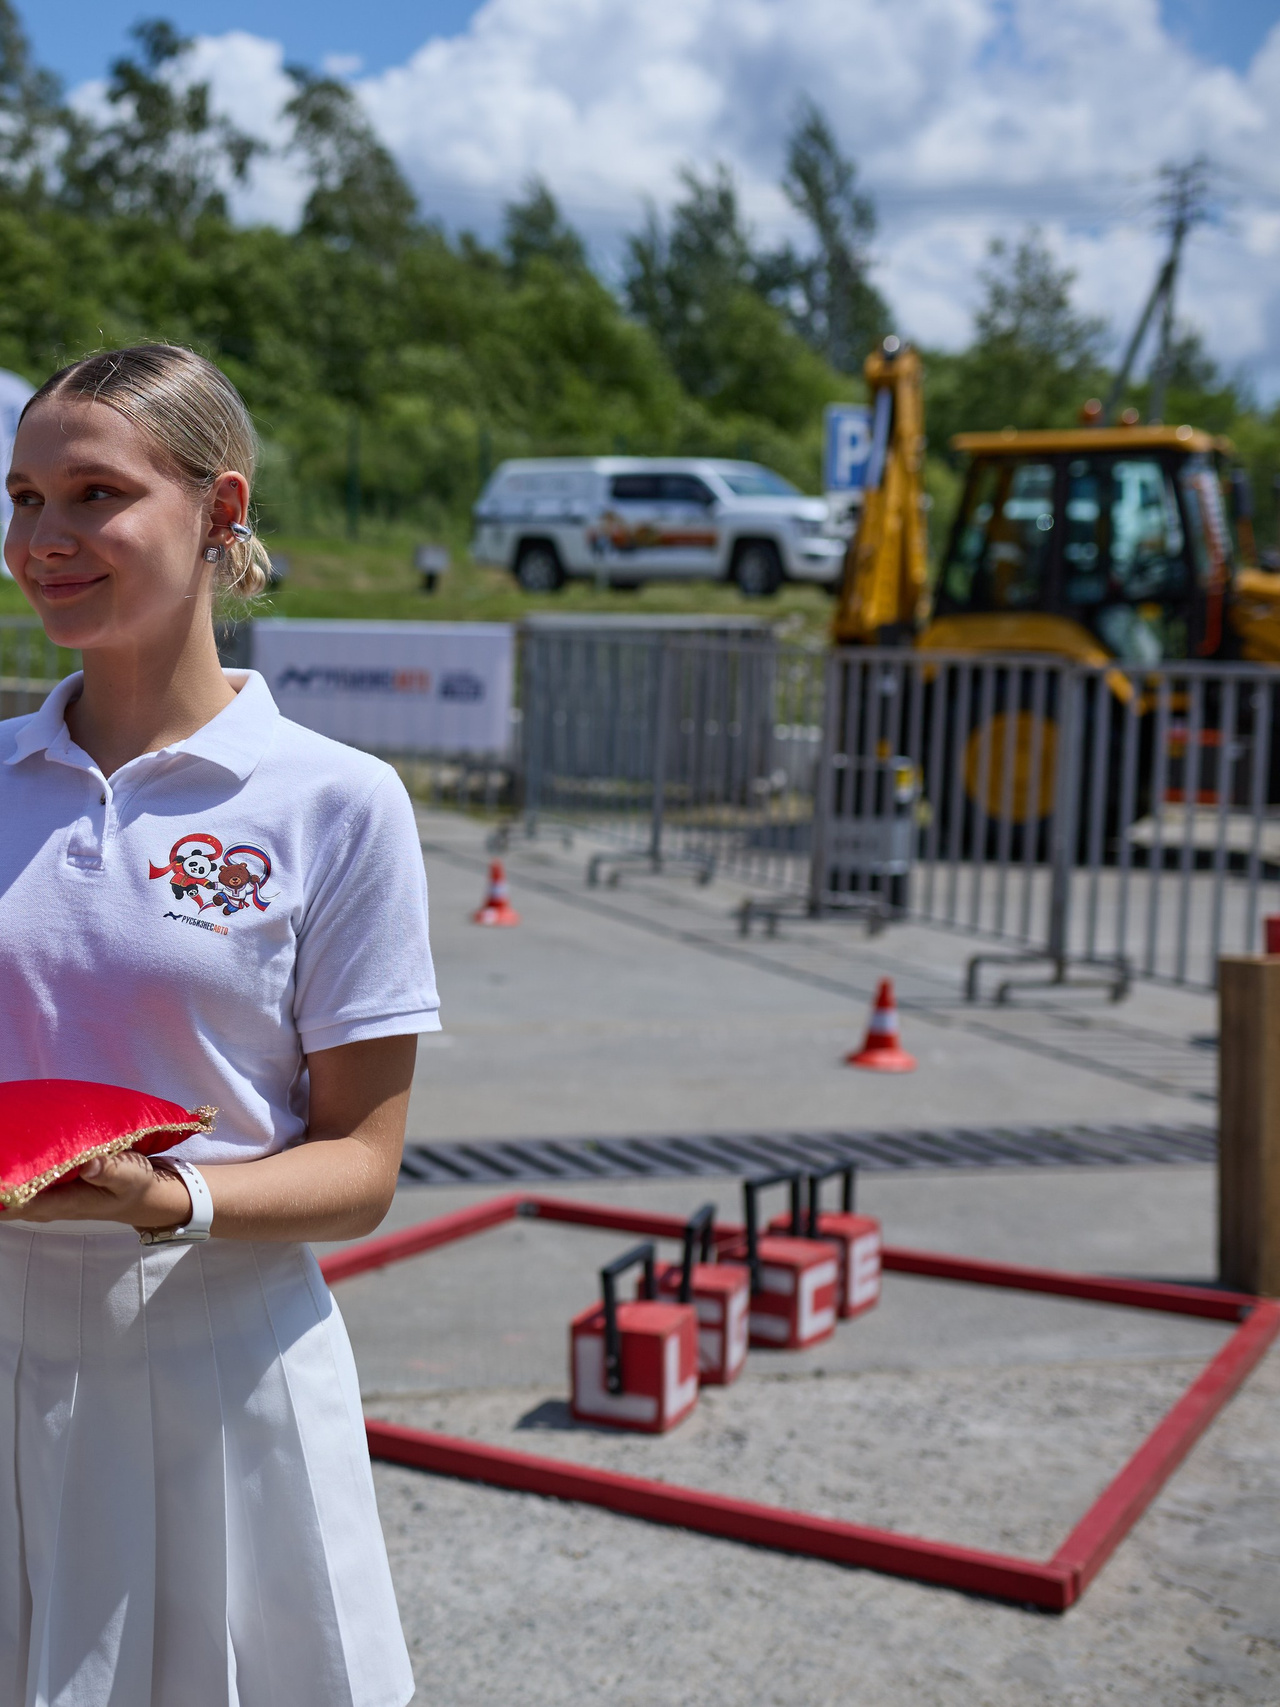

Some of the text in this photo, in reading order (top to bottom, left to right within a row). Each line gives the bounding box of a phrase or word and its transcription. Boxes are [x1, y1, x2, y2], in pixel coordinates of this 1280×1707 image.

[836, 417, 871, 483] P
[181, 915, 228, 935] РУСБИЗНЕСАВТО
[573, 1333, 659, 1424] L
[664, 1333, 698, 1421] L
